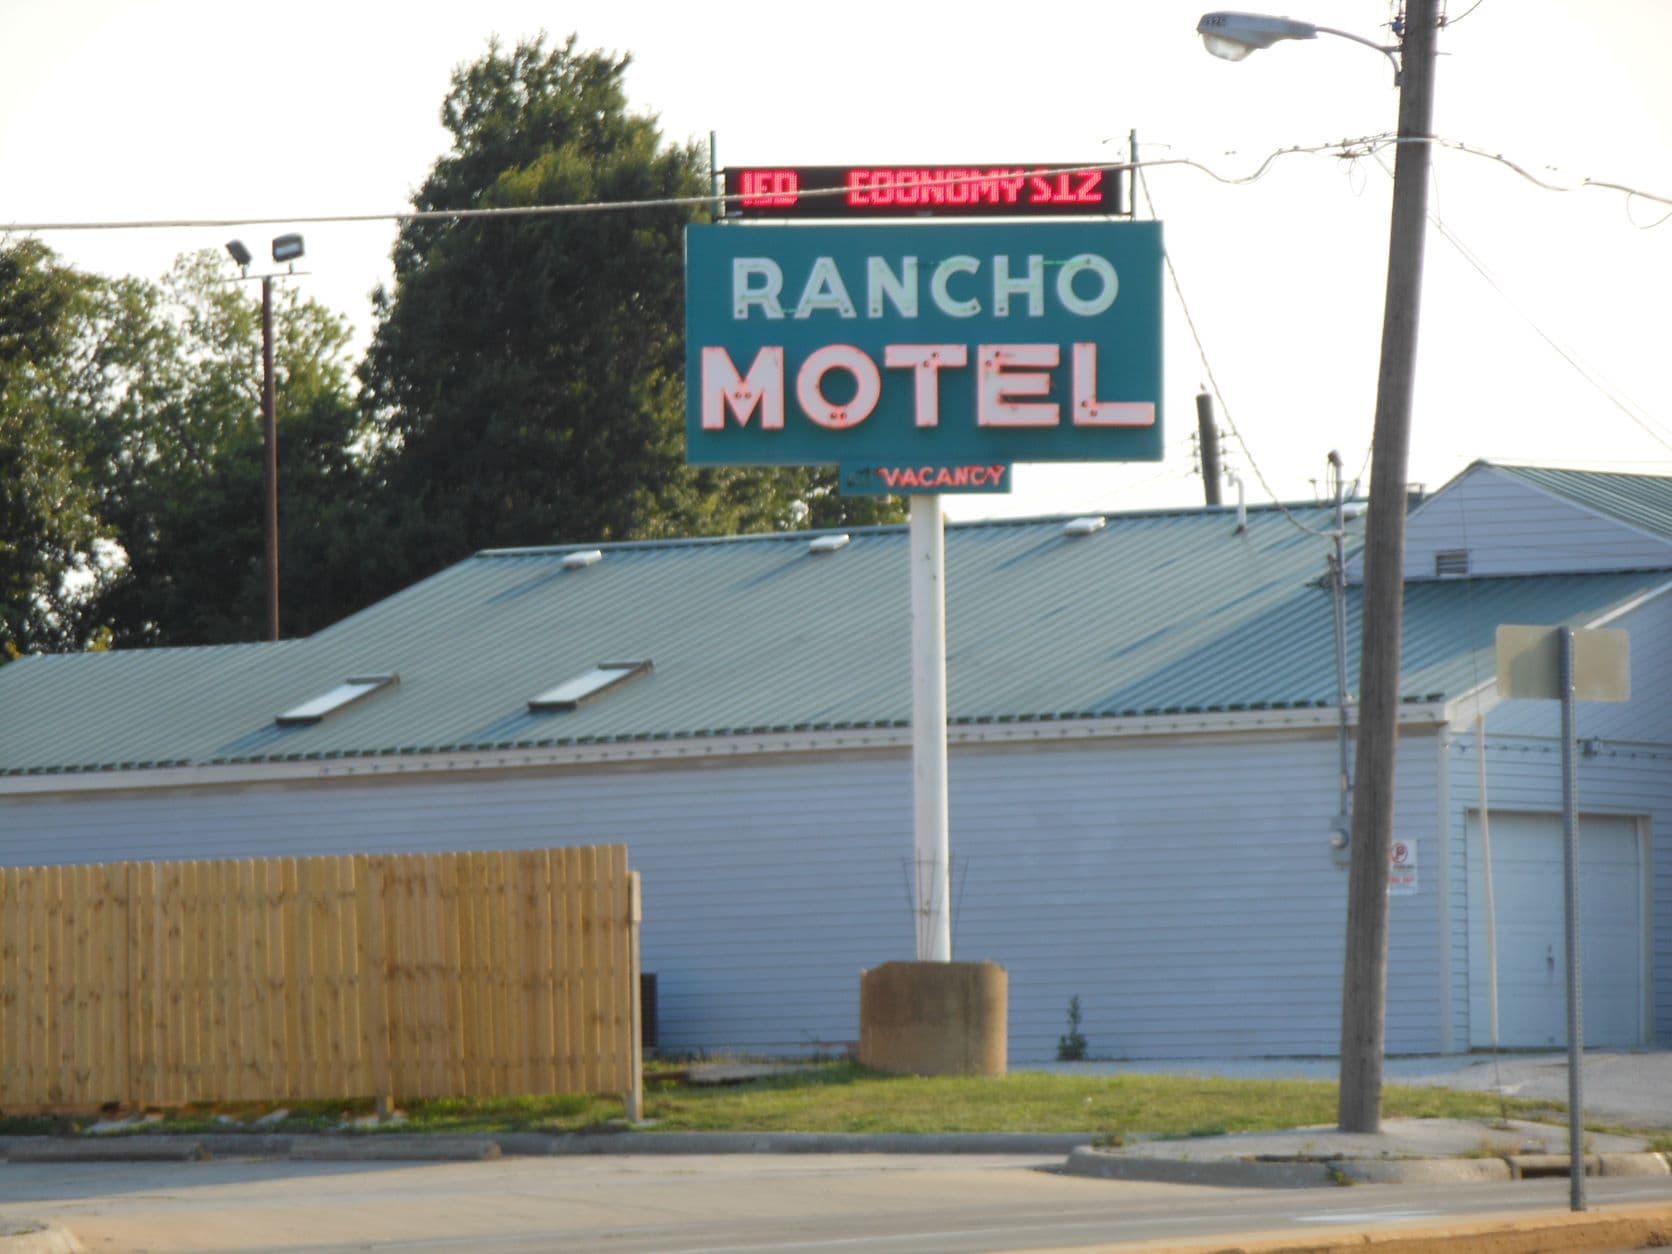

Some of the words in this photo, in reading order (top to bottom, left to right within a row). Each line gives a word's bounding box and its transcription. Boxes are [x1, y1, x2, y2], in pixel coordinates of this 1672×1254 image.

[732, 254, 1120, 320] RANCHO
[701, 343, 1156, 430] MOTEL
[878, 465, 1005, 487] VACANCY
